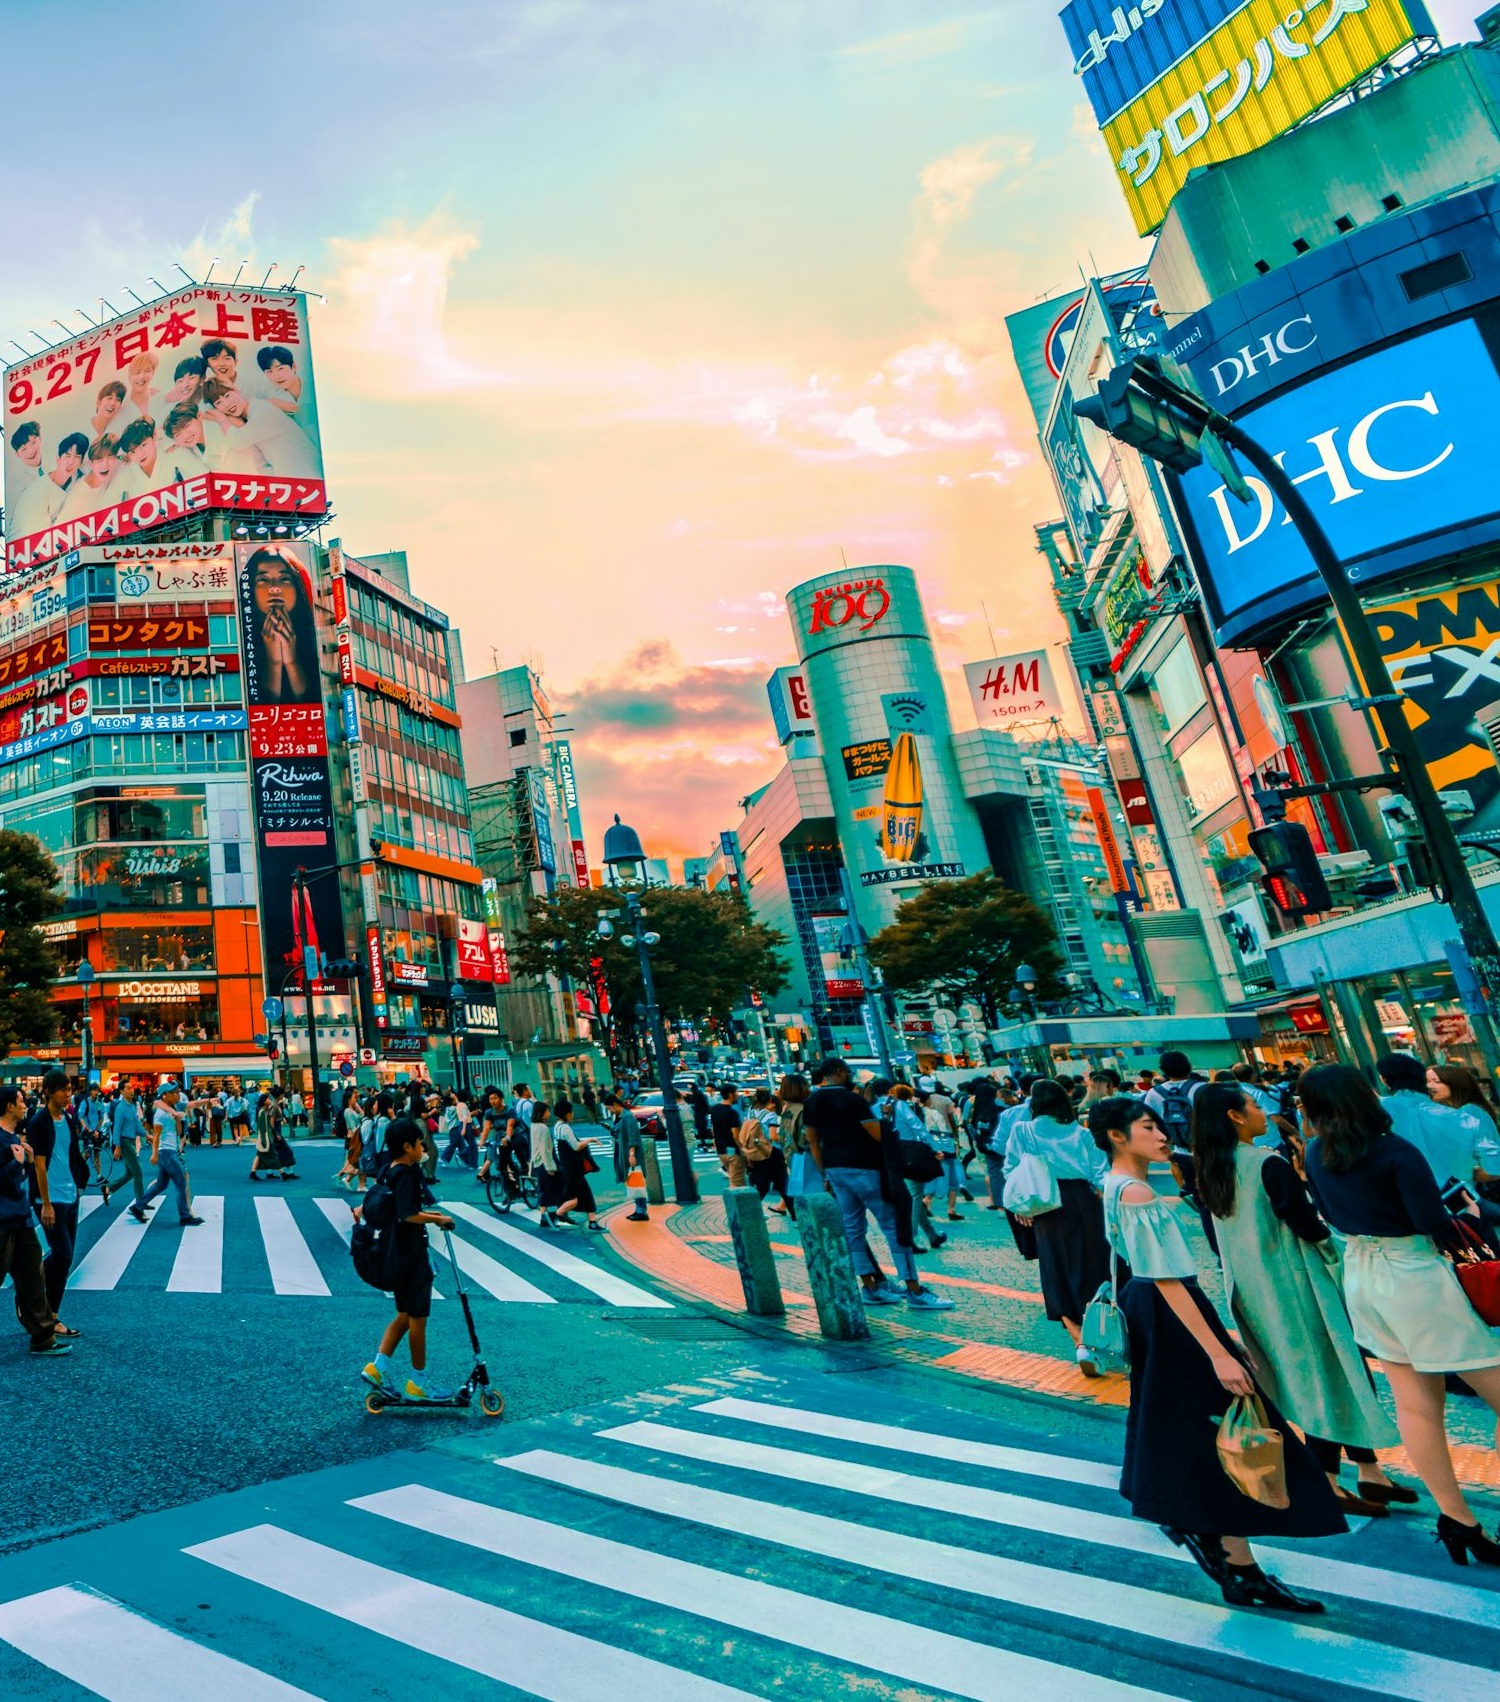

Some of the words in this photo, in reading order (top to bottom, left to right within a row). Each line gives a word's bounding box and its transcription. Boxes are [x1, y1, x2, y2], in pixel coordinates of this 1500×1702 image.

[9, 347, 101, 414] 9.27
[115, 303, 300, 370] 日本上陸
[1209, 314, 1318, 396] DHC
[1208, 391, 1454, 555] DHC
[213, 481, 321, 506] ワナワン
[157, 567, 228, 590] しゃぶ葉
[815, 579, 885, 600] SHIBUYA
[808, 587, 891, 634] 109
[89, 620, 204, 643] コンタクト
[0, 636, 66, 681] プライス
[171, 656, 226, 677] ガスト
[36, 670, 72, 697] ガスト
[979, 659, 1039, 700] H&M
[21, 702, 63, 738] ガスト
[97, 717, 131, 729] AEON
[140, 713, 243, 729] 英会話イーオン
[251, 706, 322, 726] ユリゴコロ
[992, 704, 1032, 718] 150m
[5, 728, 68, 759] 英会話イーオン
[559, 745, 570, 763] BIC
[257, 763, 324, 788] Rihwa
[262, 790, 288, 802] 9.20
[290, 792, 322, 801] Release
[562, 765, 577, 810] CAMERA
[856, 807, 877, 819] NEW
[1127, 796, 1147, 808] JTB
[888, 820, 916, 840] BIG
[861, 864, 964, 884] MAYBELLINE
[463, 943, 486, 962] アコム
[119, 981, 200, 998] L'OCCITANE
[146, 995, 187, 1003] PROVENCE
[465, 1003, 498, 1027] LUSH
